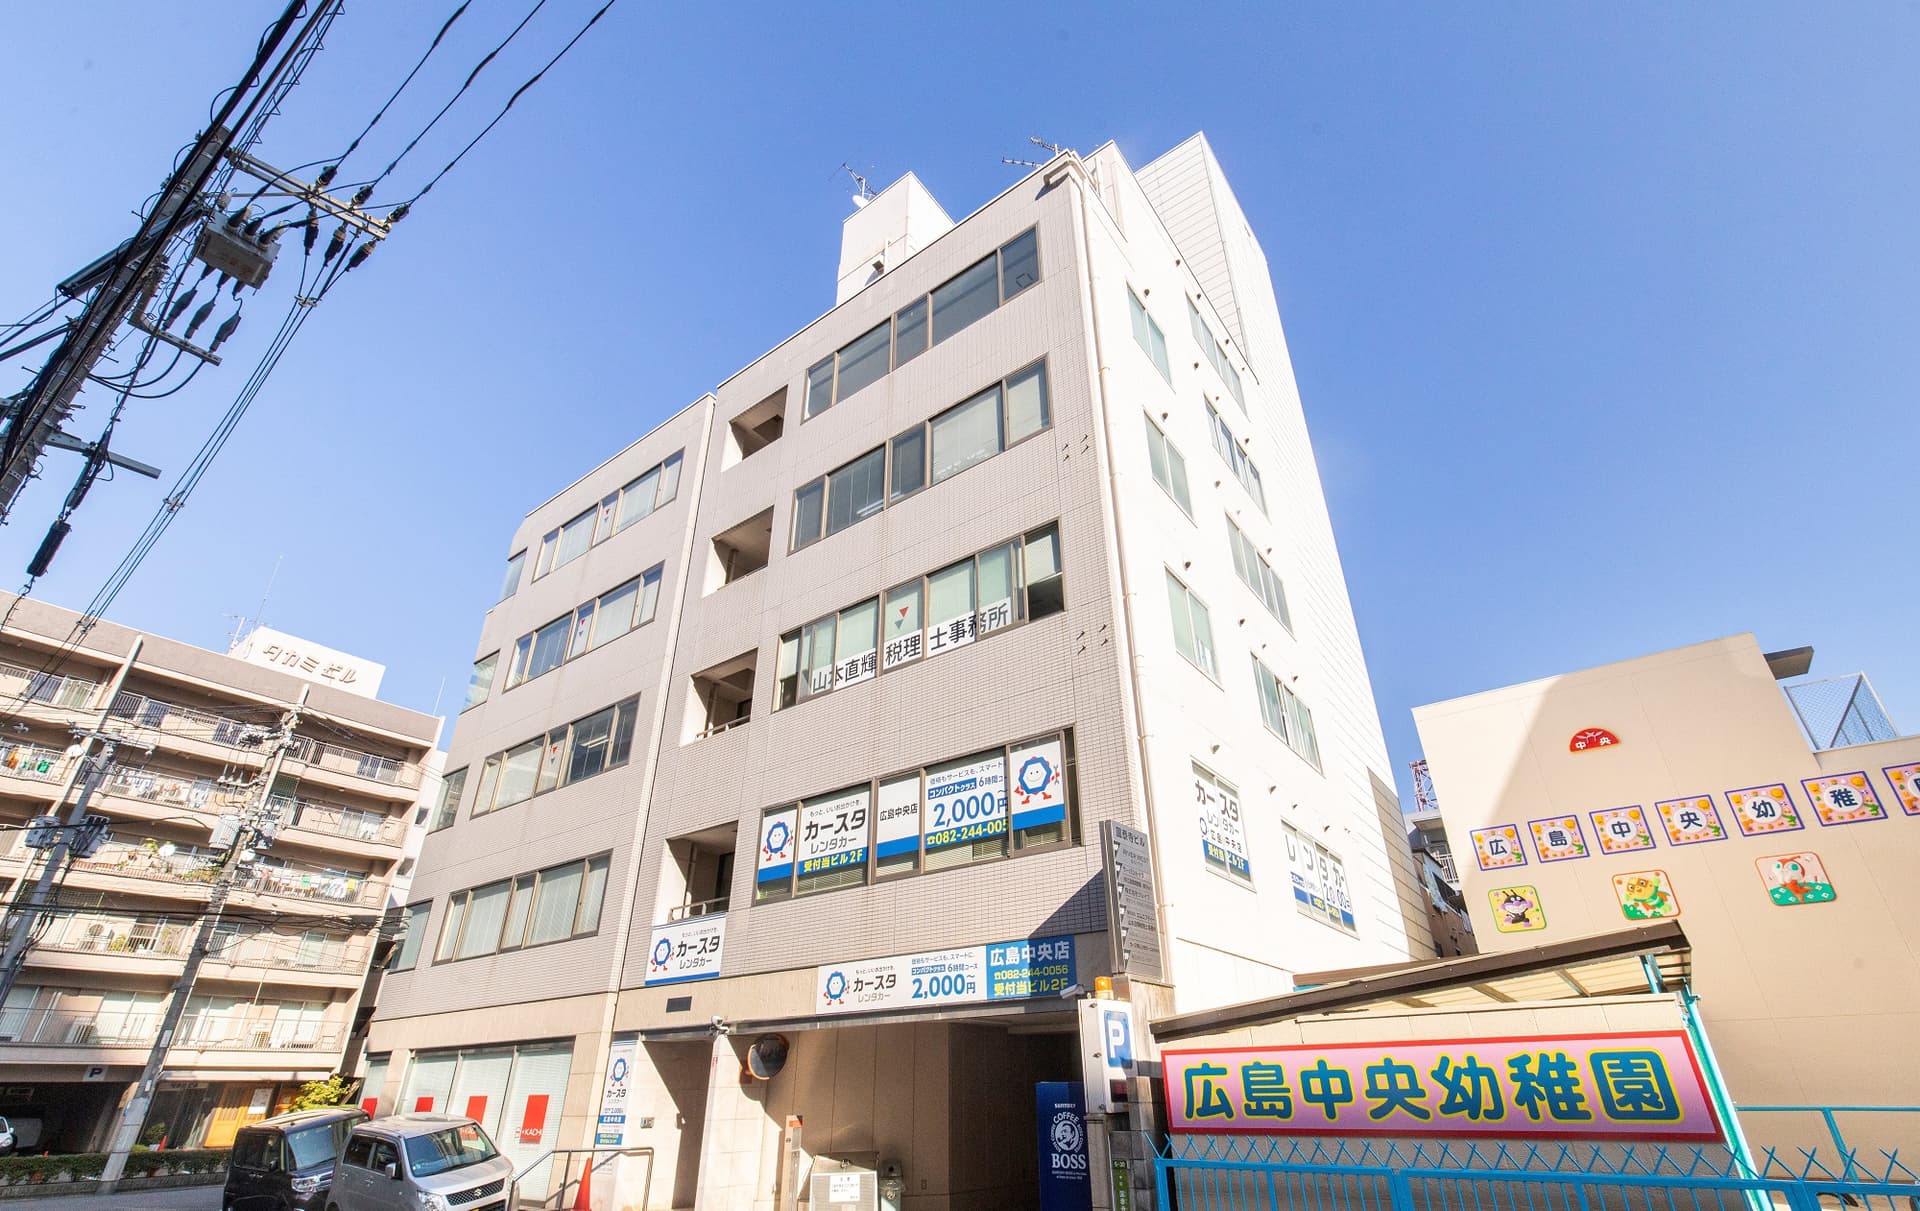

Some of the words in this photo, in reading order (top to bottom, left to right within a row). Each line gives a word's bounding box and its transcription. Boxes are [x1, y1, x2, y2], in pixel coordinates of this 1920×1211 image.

[263, 645, 357, 684] タカミビル
[1576, 735, 1612, 750] 中央
[1195, 780, 1239, 822] カースタ
[879, 803, 918, 822] 広島中央店
[804, 808, 866, 842] カースタ
[810, 836, 857, 855] レンタカー
[676, 935, 721, 958] カースタ
[990, 941, 1070, 967] 広島中央店
[679, 957, 712, 969] レンタカー
[853, 973, 897, 992] カースタ
[994, 978, 1069, 996] 受付当ビル2F
[857, 993, 891, 1004] レンタカー
[1107, 1019, 1125, 1059] P
[89, 1066, 103, 1079] P
[607, 1088, 627, 1099] カースタ
[1182, 1047, 1685, 1124] 広島中央幼稚園
[1053, 1111, 1080, 1125] COFFEE
[1051, 1153, 1087, 1170] BOSS
